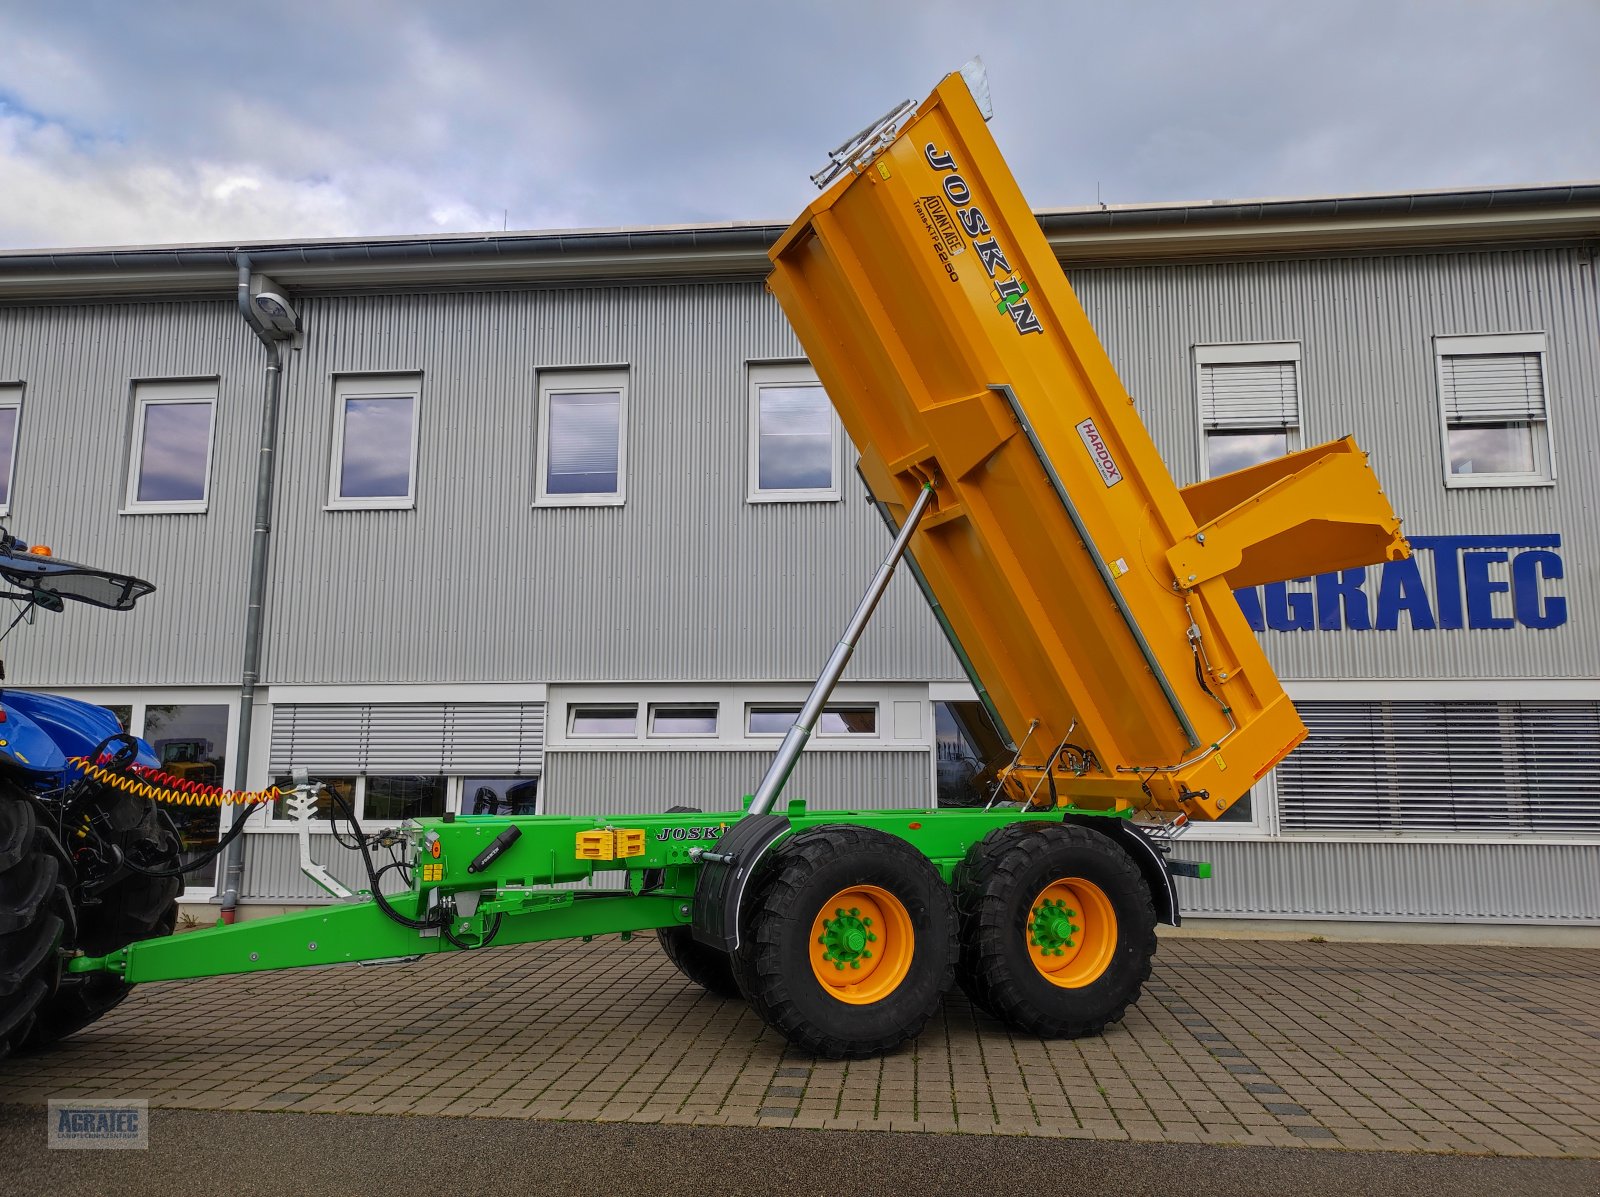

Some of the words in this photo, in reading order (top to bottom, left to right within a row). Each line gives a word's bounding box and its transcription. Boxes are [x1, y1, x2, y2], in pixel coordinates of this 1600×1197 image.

[920, 196, 962, 252] ADVANTAGE
[924, 142, 1044, 336] JOSKIN
[1083, 423, 1119, 478] HARDOX
